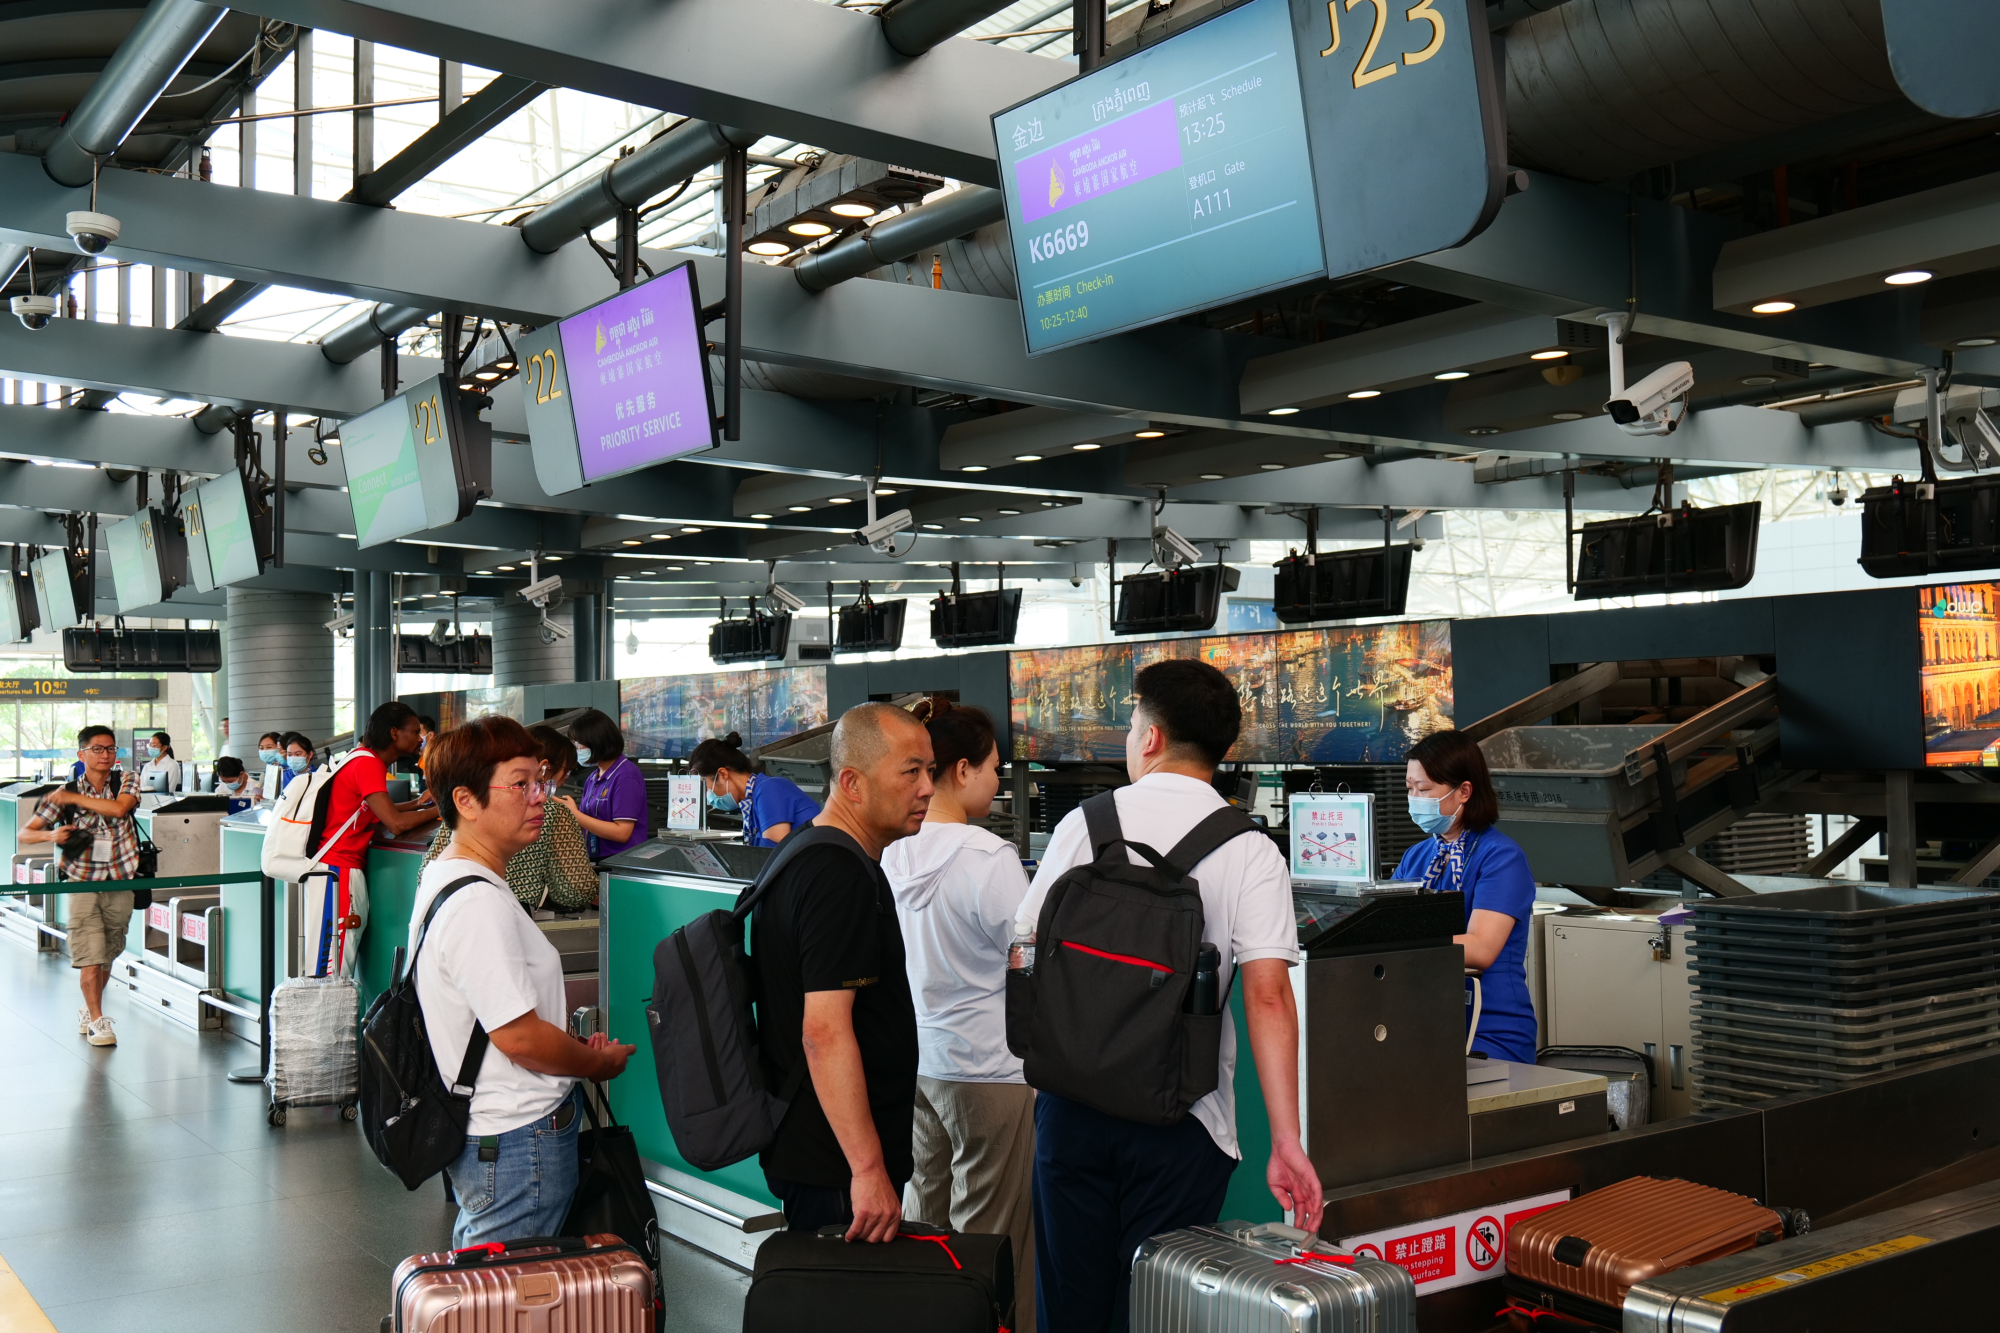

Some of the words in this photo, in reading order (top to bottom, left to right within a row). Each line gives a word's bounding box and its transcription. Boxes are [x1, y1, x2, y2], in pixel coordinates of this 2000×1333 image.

[1320, 0, 1446, 89] J23
[1221, 76, 1262, 101] Schedule
[1178, 93, 1216, 118] 预计起飞
[1012, 117, 1045, 151] 金边
[1182, 112, 1226, 145] 13:25
[1072, 162, 1097, 177] CAMBODIA
[1097, 153, 1118, 169] ANGKOR
[1118, 148, 1127, 160] AIR
[1224, 160, 1245, 176] Gate
[1074, 159, 1138, 197] 柬埔寨国家航空
[1188, 169, 1216, 190] 登机口
[1193, 188, 1232, 219] A111
[1029, 220, 1089, 263] K6669
[1037, 285, 1071, 307] 办票时间
[1077, 274, 1114, 294] Check-in
[1040, 306, 1088, 330] 10:25-12:40
[597, 350, 625, 368] CAMBODIA
[625, 341, 648, 357] ANGKOR
[648, 336, 658, 348] AIR
[526, 349, 562, 404] J22
[616, 391, 656, 420] 优先服务
[415, 395, 442, 445] J21
[600, 424, 640, 451] PRIORITY
[643, 411, 682, 438] SERVICE
[358, 471, 388, 494] Connect
[33, 681, 52, 695] 10
[53, 681, 68, 689] 号门
[1543, 793, 1562, 802] 2016
[1312, 811, 1343, 820] 禁止托运
[1411, 1256, 1443, 1269] stepping
[1413, 1268, 1440, 1280] surface
